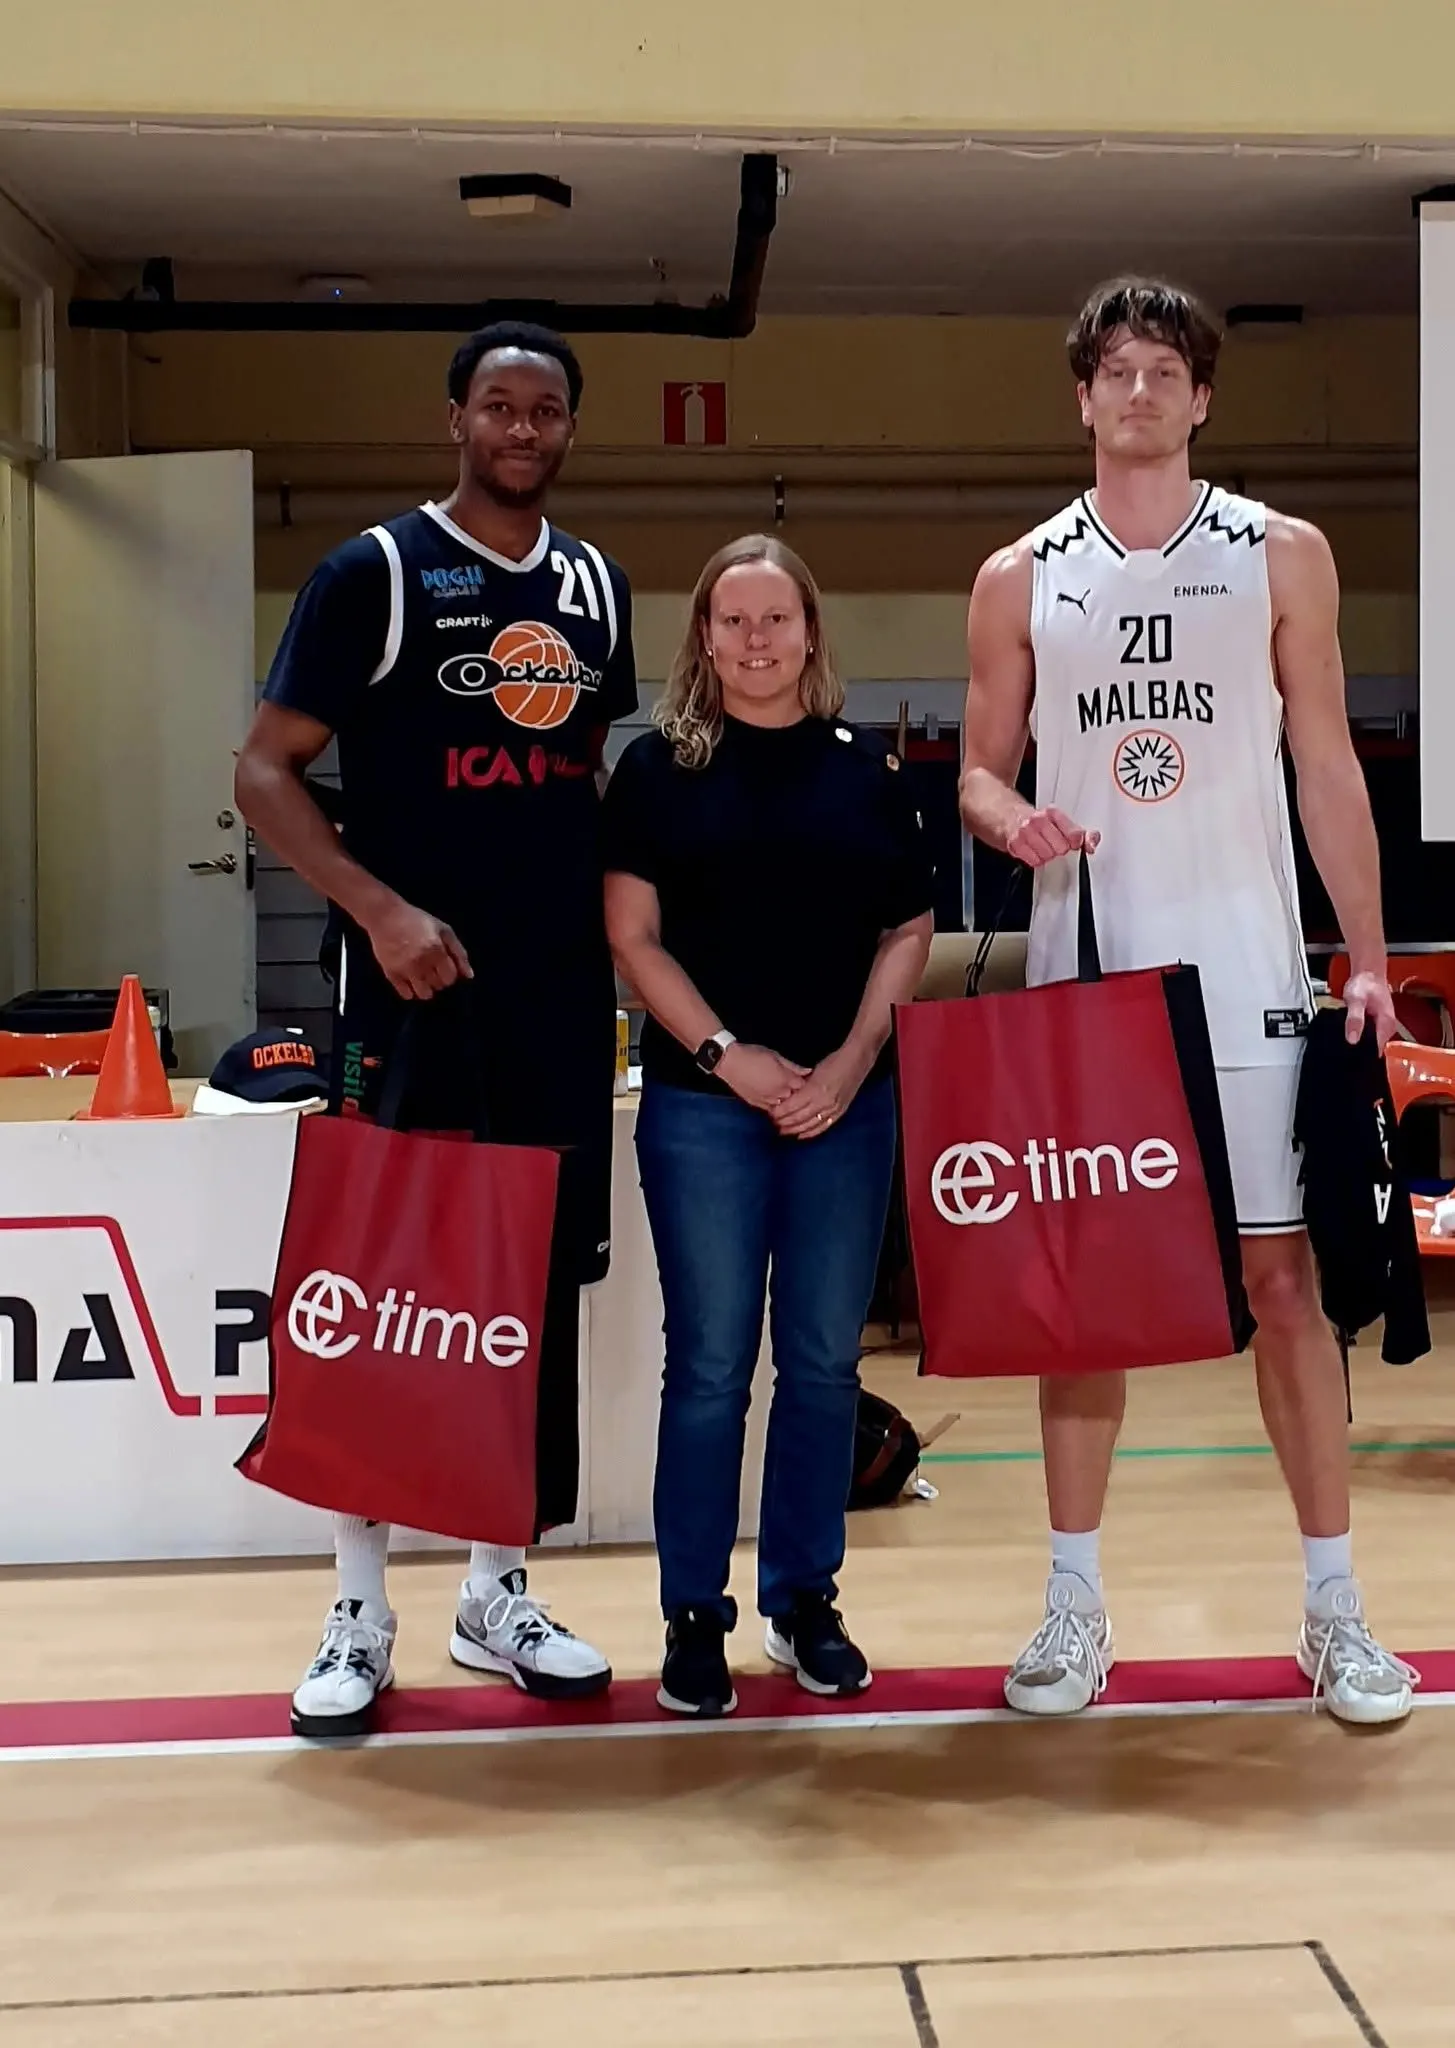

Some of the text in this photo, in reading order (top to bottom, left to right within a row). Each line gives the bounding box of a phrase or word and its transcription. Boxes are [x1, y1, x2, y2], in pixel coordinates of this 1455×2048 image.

[550, 550, 601, 622] 21
[435, 617, 480, 629] CRAFT
[1119, 613, 1172, 664] 20
[1077, 680, 1214, 734] MALBAS
[447, 746, 523, 787] ICA
[1023, 1137, 1180, 1204] time
[373, 1287, 530, 1368] time
